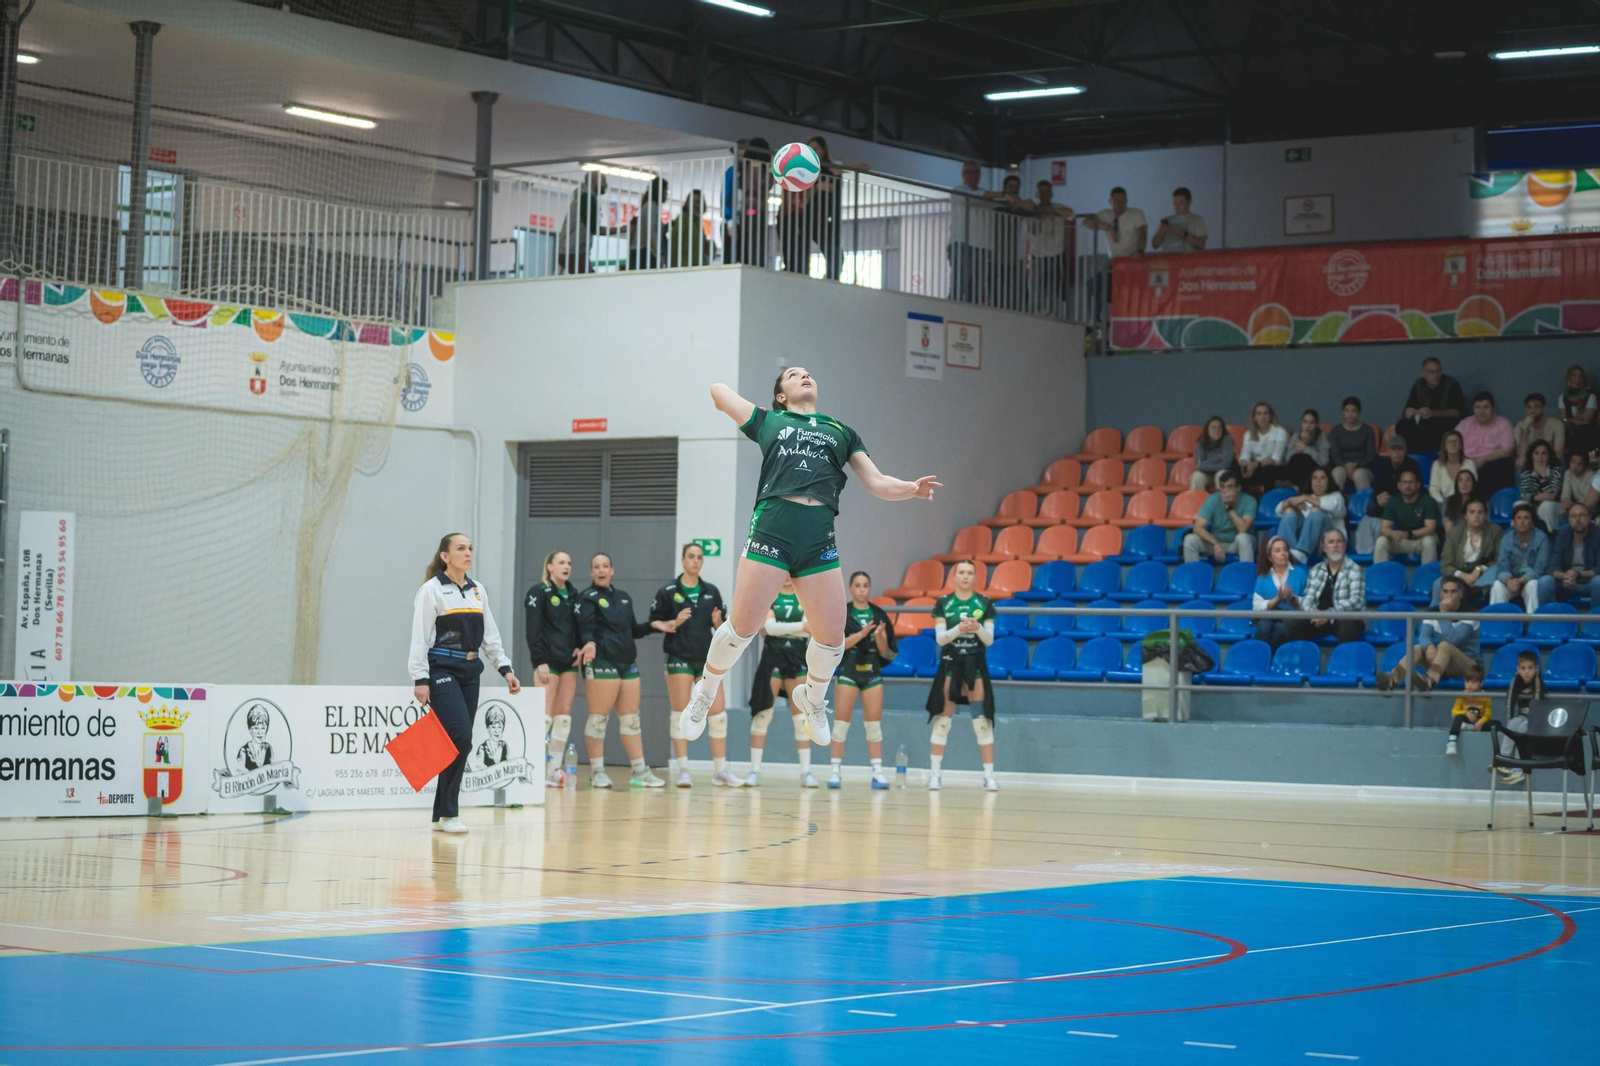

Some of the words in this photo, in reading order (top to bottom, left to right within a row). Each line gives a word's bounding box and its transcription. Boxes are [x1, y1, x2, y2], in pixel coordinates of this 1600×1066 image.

[58, 336, 70, 347] de
[280, 375, 297, 387] Dos
[796, 434, 827, 446] Unicaja
[797, 428, 838, 447] Fundación
[59, 519, 67, 532] 60
[59, 535, 67, 548] 95
[751, 541, 780, 556] MAX
[23, 549, 31, 568] 108
[58, 550, 66, 562] 54
[34, 553, 42, 604] Hermanas
[58, 566, 66, 585] 955
[21, 571, 31, 611] España,
[45, 568, 55, 611] (Sevilla)
[57, 595, 65, 607] 78
[33, 606, 41, 626] Dos
[56, 610, 64, 624] 66
[785, 604, 793, 618] 7
[56, 626, 64, 639] 78
[55, 642, 63, 661] 607
[87, 708, 116, 737] de
[325, 706, 349, 728] EL
[330, 732, 358, 754] DE
[0, 757, 116, 781] ermanas
[335, 769, 349, 778] 955
[350, 769, 364, 778] 236
[365, 769, 379, 778] 678
[382, 769, 394, 778] 617
[466, 777, 471, 788] El
[494, 769, 502, 780] de
[503, 762, 523, 777] María
[225, 782, 231, 794] El
[233, 777, 256, 793] Rincón
[257, 772, 266, 785] de
[266, 766, 289, 781] María
[108, 793, 135, 804] DEPORTE
[305, 788, 317, 800] C/
[317, 788, 346, 797] LAGUNA
[347, 788, 355, 796] DE
[357, 787, 385, 796] MAESTRE
[390, 787, 399, 795] 52
[400, 787, 414, 795] DOS
